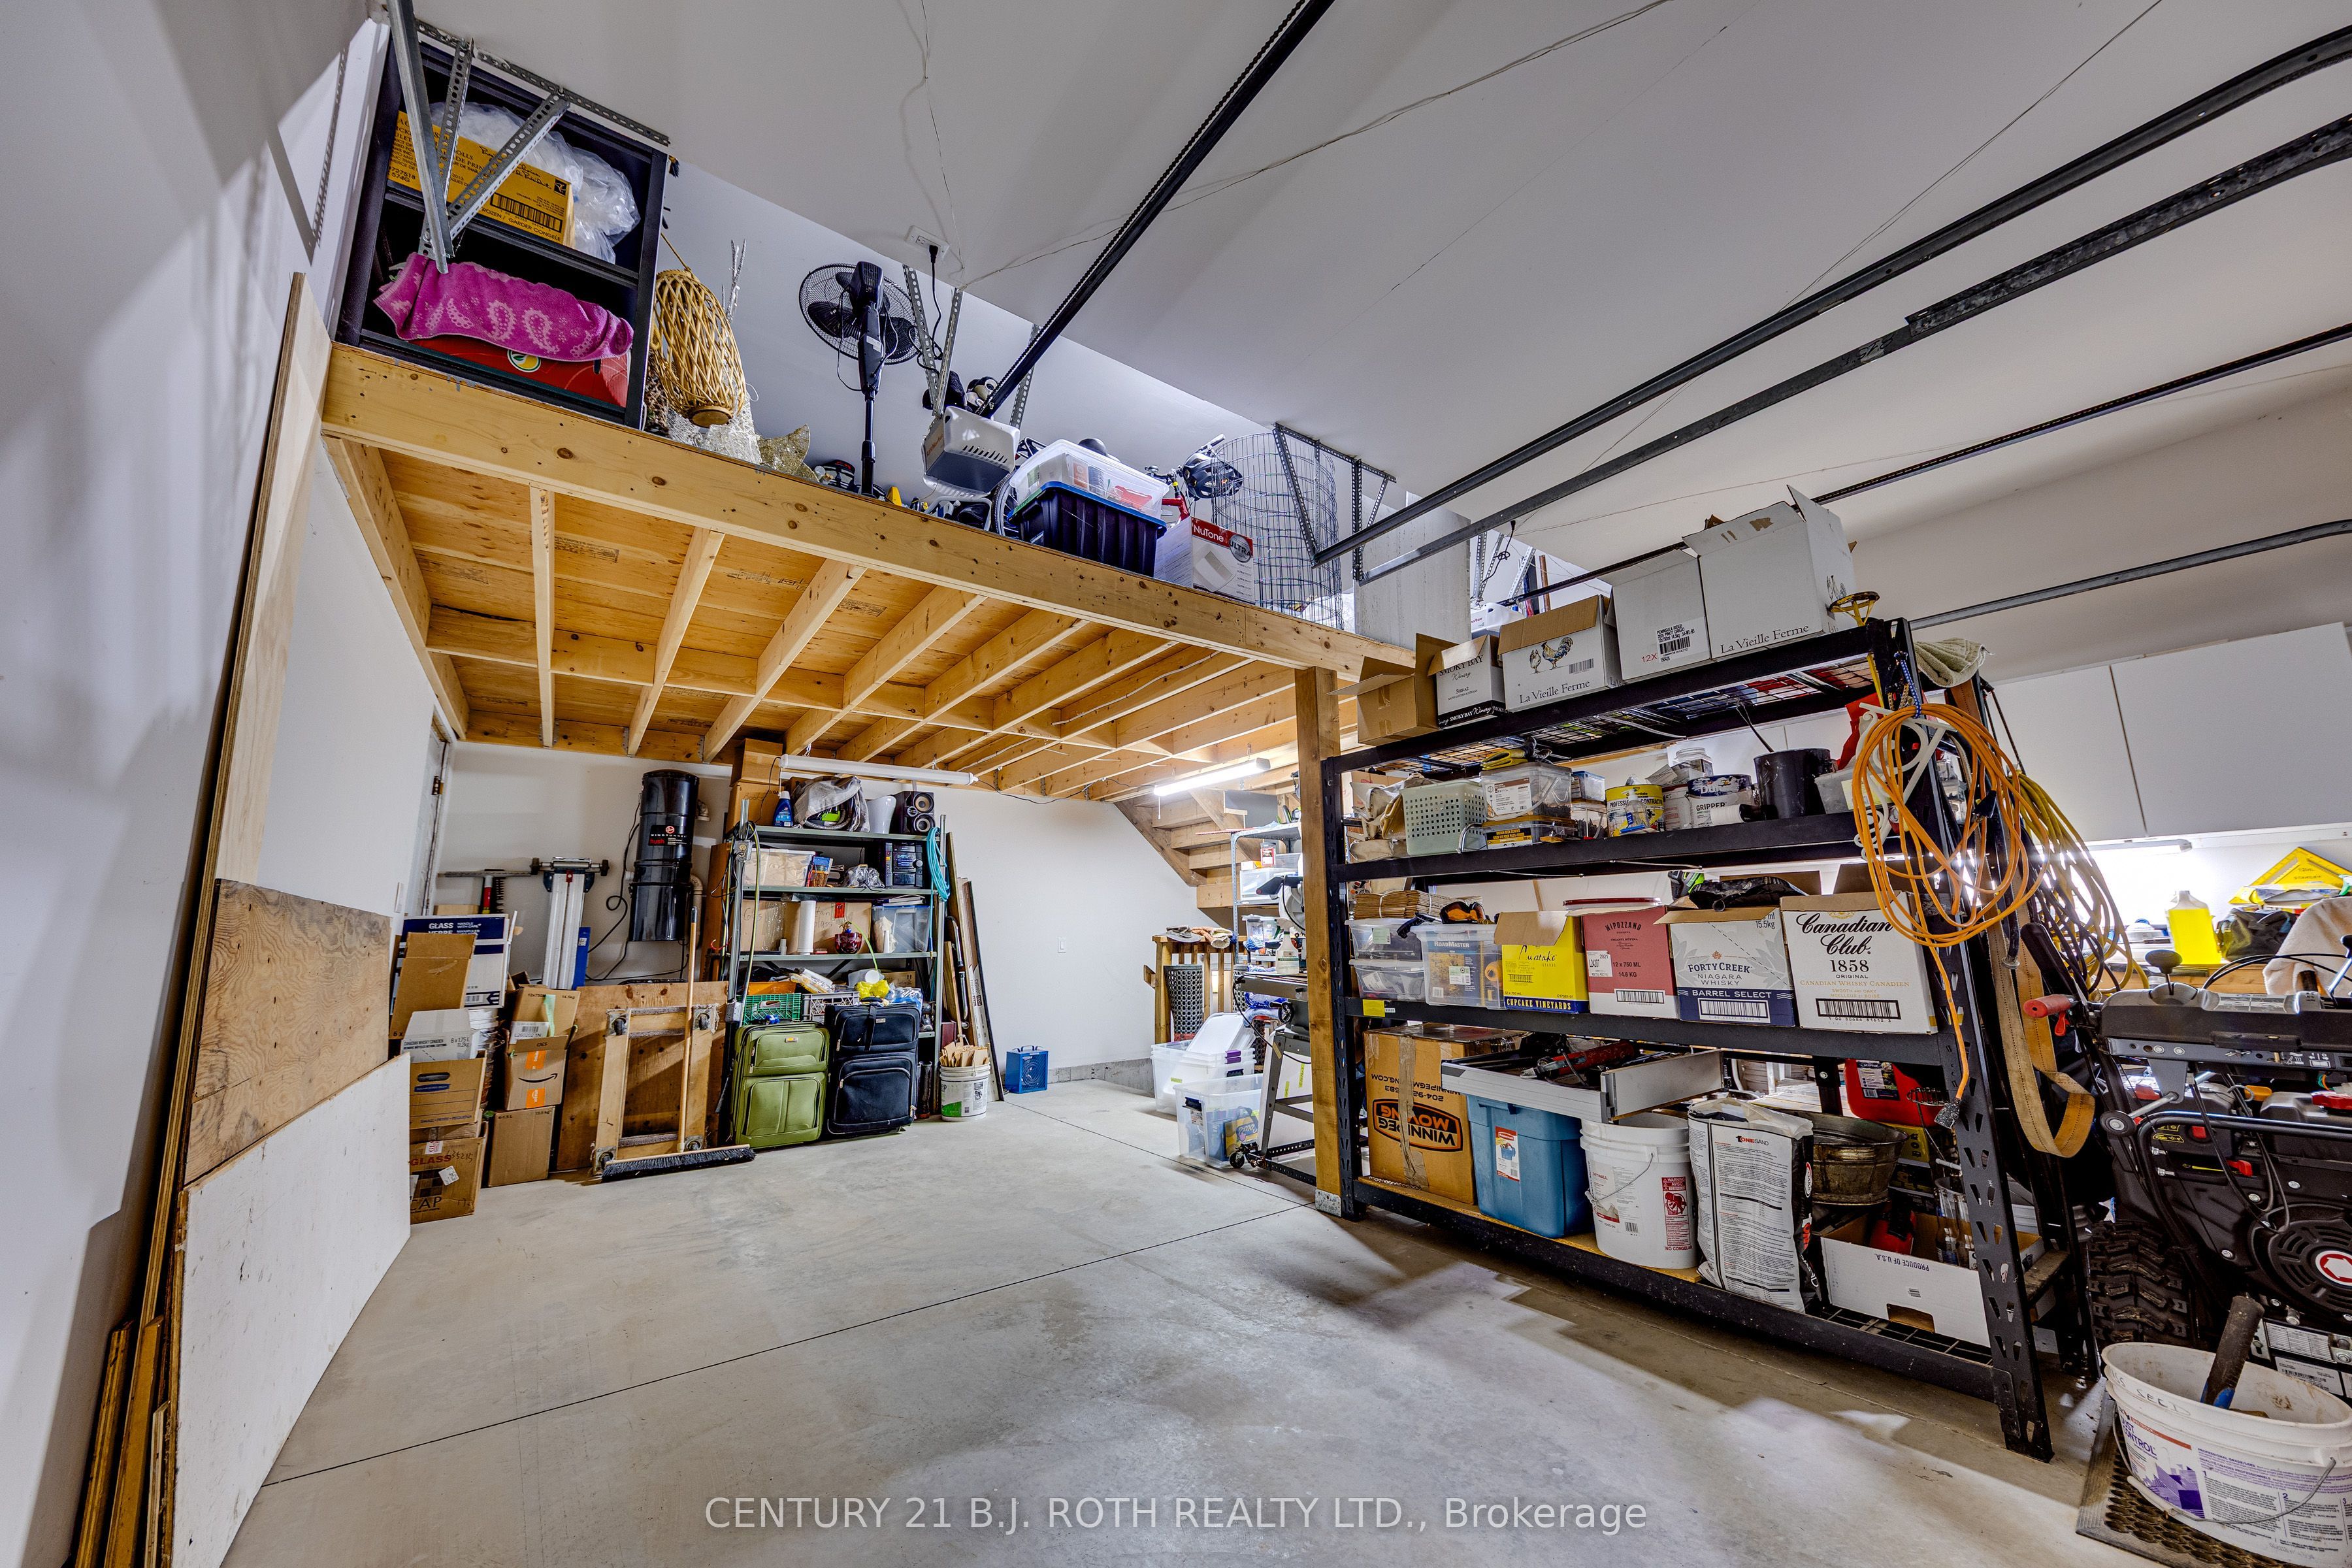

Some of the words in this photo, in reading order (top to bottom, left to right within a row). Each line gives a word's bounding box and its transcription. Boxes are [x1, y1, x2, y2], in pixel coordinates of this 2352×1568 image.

[455, 150, 474, 160] OLLS
[481, 206, 502, 219] ROZEN
[508, 218, 532, 230] GARDER
[1194, 525, 1224, 542] NuTone
[1229, 539, 1252, 558] ULTRA
[1721, 644, 1735, 653] La
[1735, 634, 1769, 649] Vieille
[1772, 625, 1809, 640] Ferme
[1439, 662, 1467, 676] SMOKY
[1468, 655, 1484, 667] BAY
[1452, 672, 1471, 681] Winery
[1520, 694, 1531, 704] La
[1531, 687, 1560, 699] Vieille
[1561, 681, 1590, 693] Ferme
[1450, 713, 1464, 722] SMOKY
[1472, 706, 1492, 717] Winery
[1696, 802, 1725, 811] GRIPPER
[816, 906, 830, 916] tain
[815, 917, 832, 928] lass
[1605, 921, 1642, 932] NIPOZZANO
[1756, 921, 1776, 929] 15.5kg
[1796, 913, 1893, 934] Canadian
[1820, 934, 1872, 955] Club
[1688, 963, 1718, 973] FORTY
[1719, 962, 1750, 973] CREEK
[1830, 959, 1869, 972] 1858
[1507, 998, 1534, 1007] CUPCAKE
[1535, 1000, 1571, 1010] VINEYARDS
[1380, 1105, 1449, 1131] MOVNG
[410, 1154, 452, 1166] GLASS
[1592, 1171, 1609, 1181] DRYWALL
[1903, 1260, 1929, 1271] PRODUCE
[2198, 1448, 2228, 1461] PROFESSIONAL
[2229, 1458, 2255, 1468] GRADE/USES
[2234, 1467, 2271, 1480] PROFESSIONNELS
